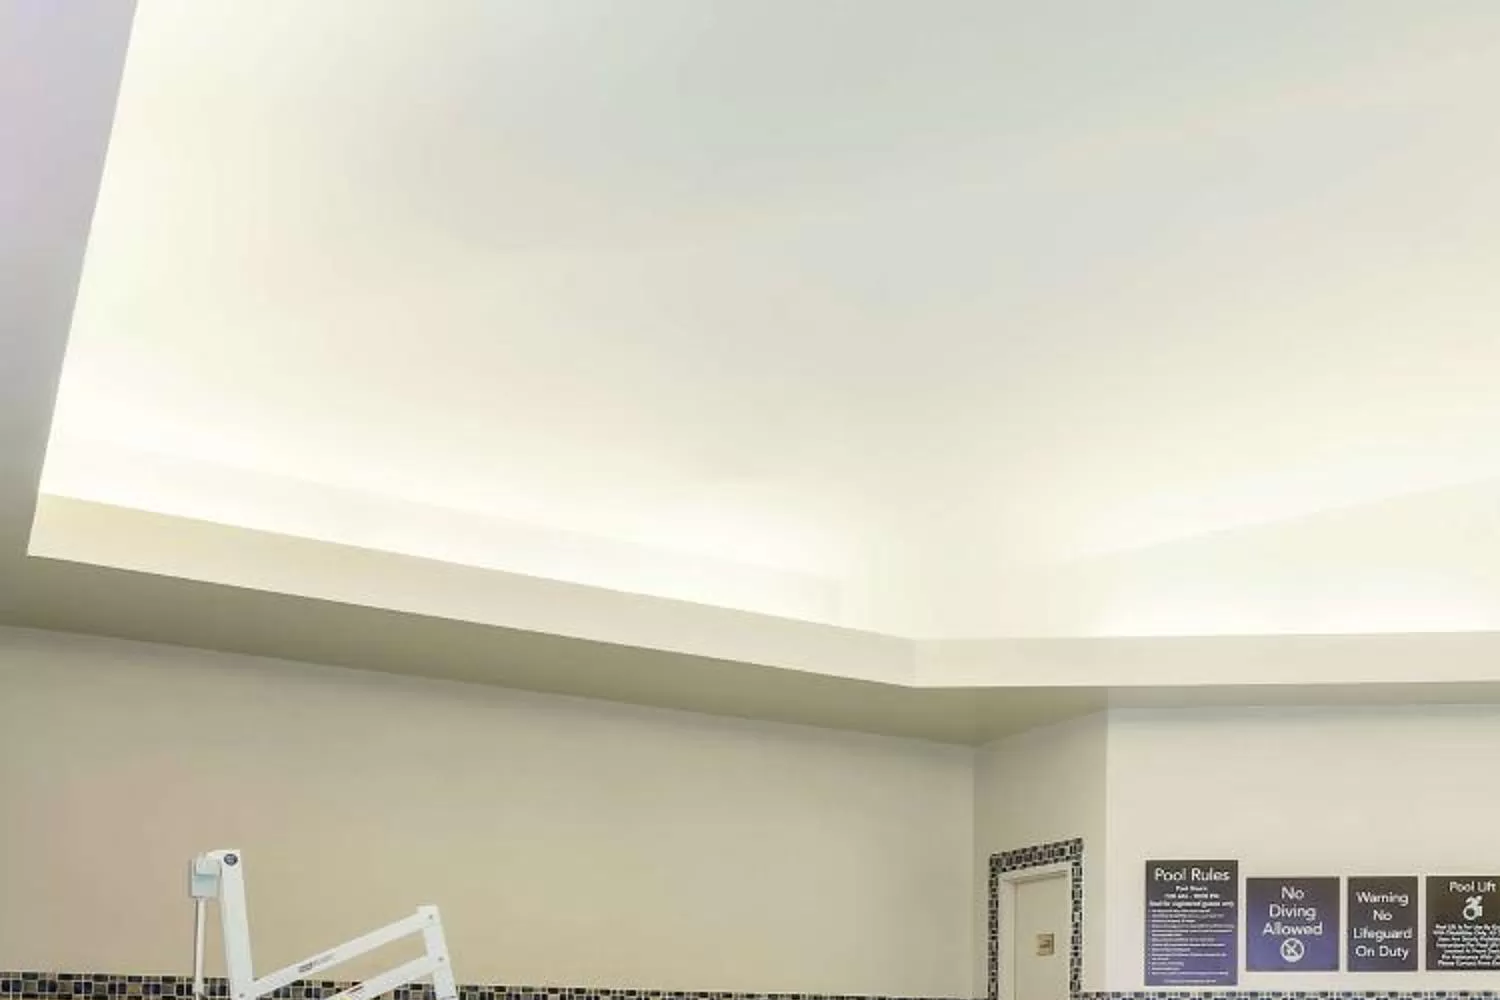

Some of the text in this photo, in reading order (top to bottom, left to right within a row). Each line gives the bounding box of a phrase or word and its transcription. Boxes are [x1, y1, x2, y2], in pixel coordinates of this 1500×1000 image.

[1155, 867, 1230, 881] Pool Rules
[1280, 886, 1304, 900] No
[1449, 880, 1497, 892] Pool Lift
[1355, 891, 1409, 906] Warning
[1269, 903, 1316, 921] Diving
[1373, 909, 1393, 921] No
[1262, 921, 1323, 935] Allowed
[1353, 927, 1413, 943] Lifeguard
[1355, 945, 1409, 960] On Duty
